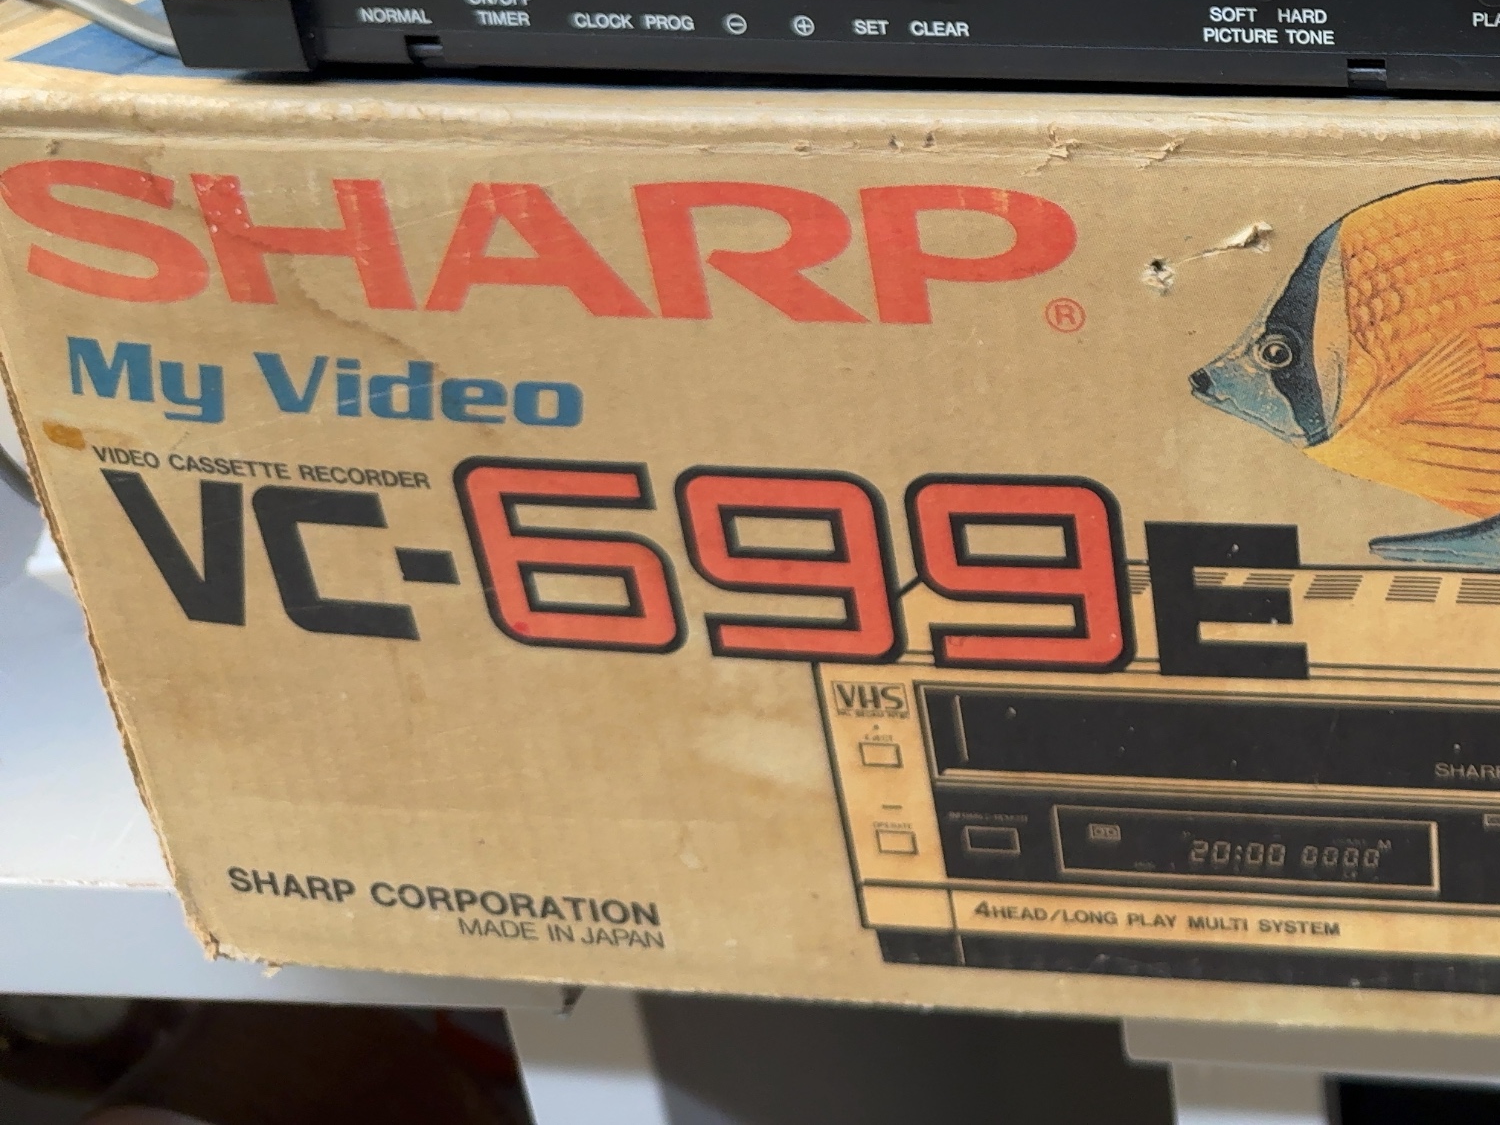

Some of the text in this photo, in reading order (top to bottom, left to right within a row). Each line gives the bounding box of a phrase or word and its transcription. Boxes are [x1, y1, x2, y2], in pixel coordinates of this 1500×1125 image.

[357, 7, 433, 25] NORMAL
[475, 9, 531, 27] TIMER
[571, 13, 634, 30] CLOCK
[642, 14, 695, 32] PROG
[1209, 6, 1257, 23] SOFT
[1277, 7, 1328, 25] HARD
[853, 19, 889, 36] SET
[909, 20, 970, 37] CLEAR
[1203, 27, 1336, 46] PICTURE TONE
[0, 159, 1078, 326] SHARP
[66, 335, 585, 429] My Video
[93, 445, 431, 490] VIDEO CASSETTE RECORDER
[836, 683, 904, 710] VHS
[227, 864, 661, 927] SHARP CORPORATION
[973, 900, 1341, 936] 4HEAD/LONG PLAY MULTI SYSTEM
[457, 916, 666, 950] MADE IN JAPAN
